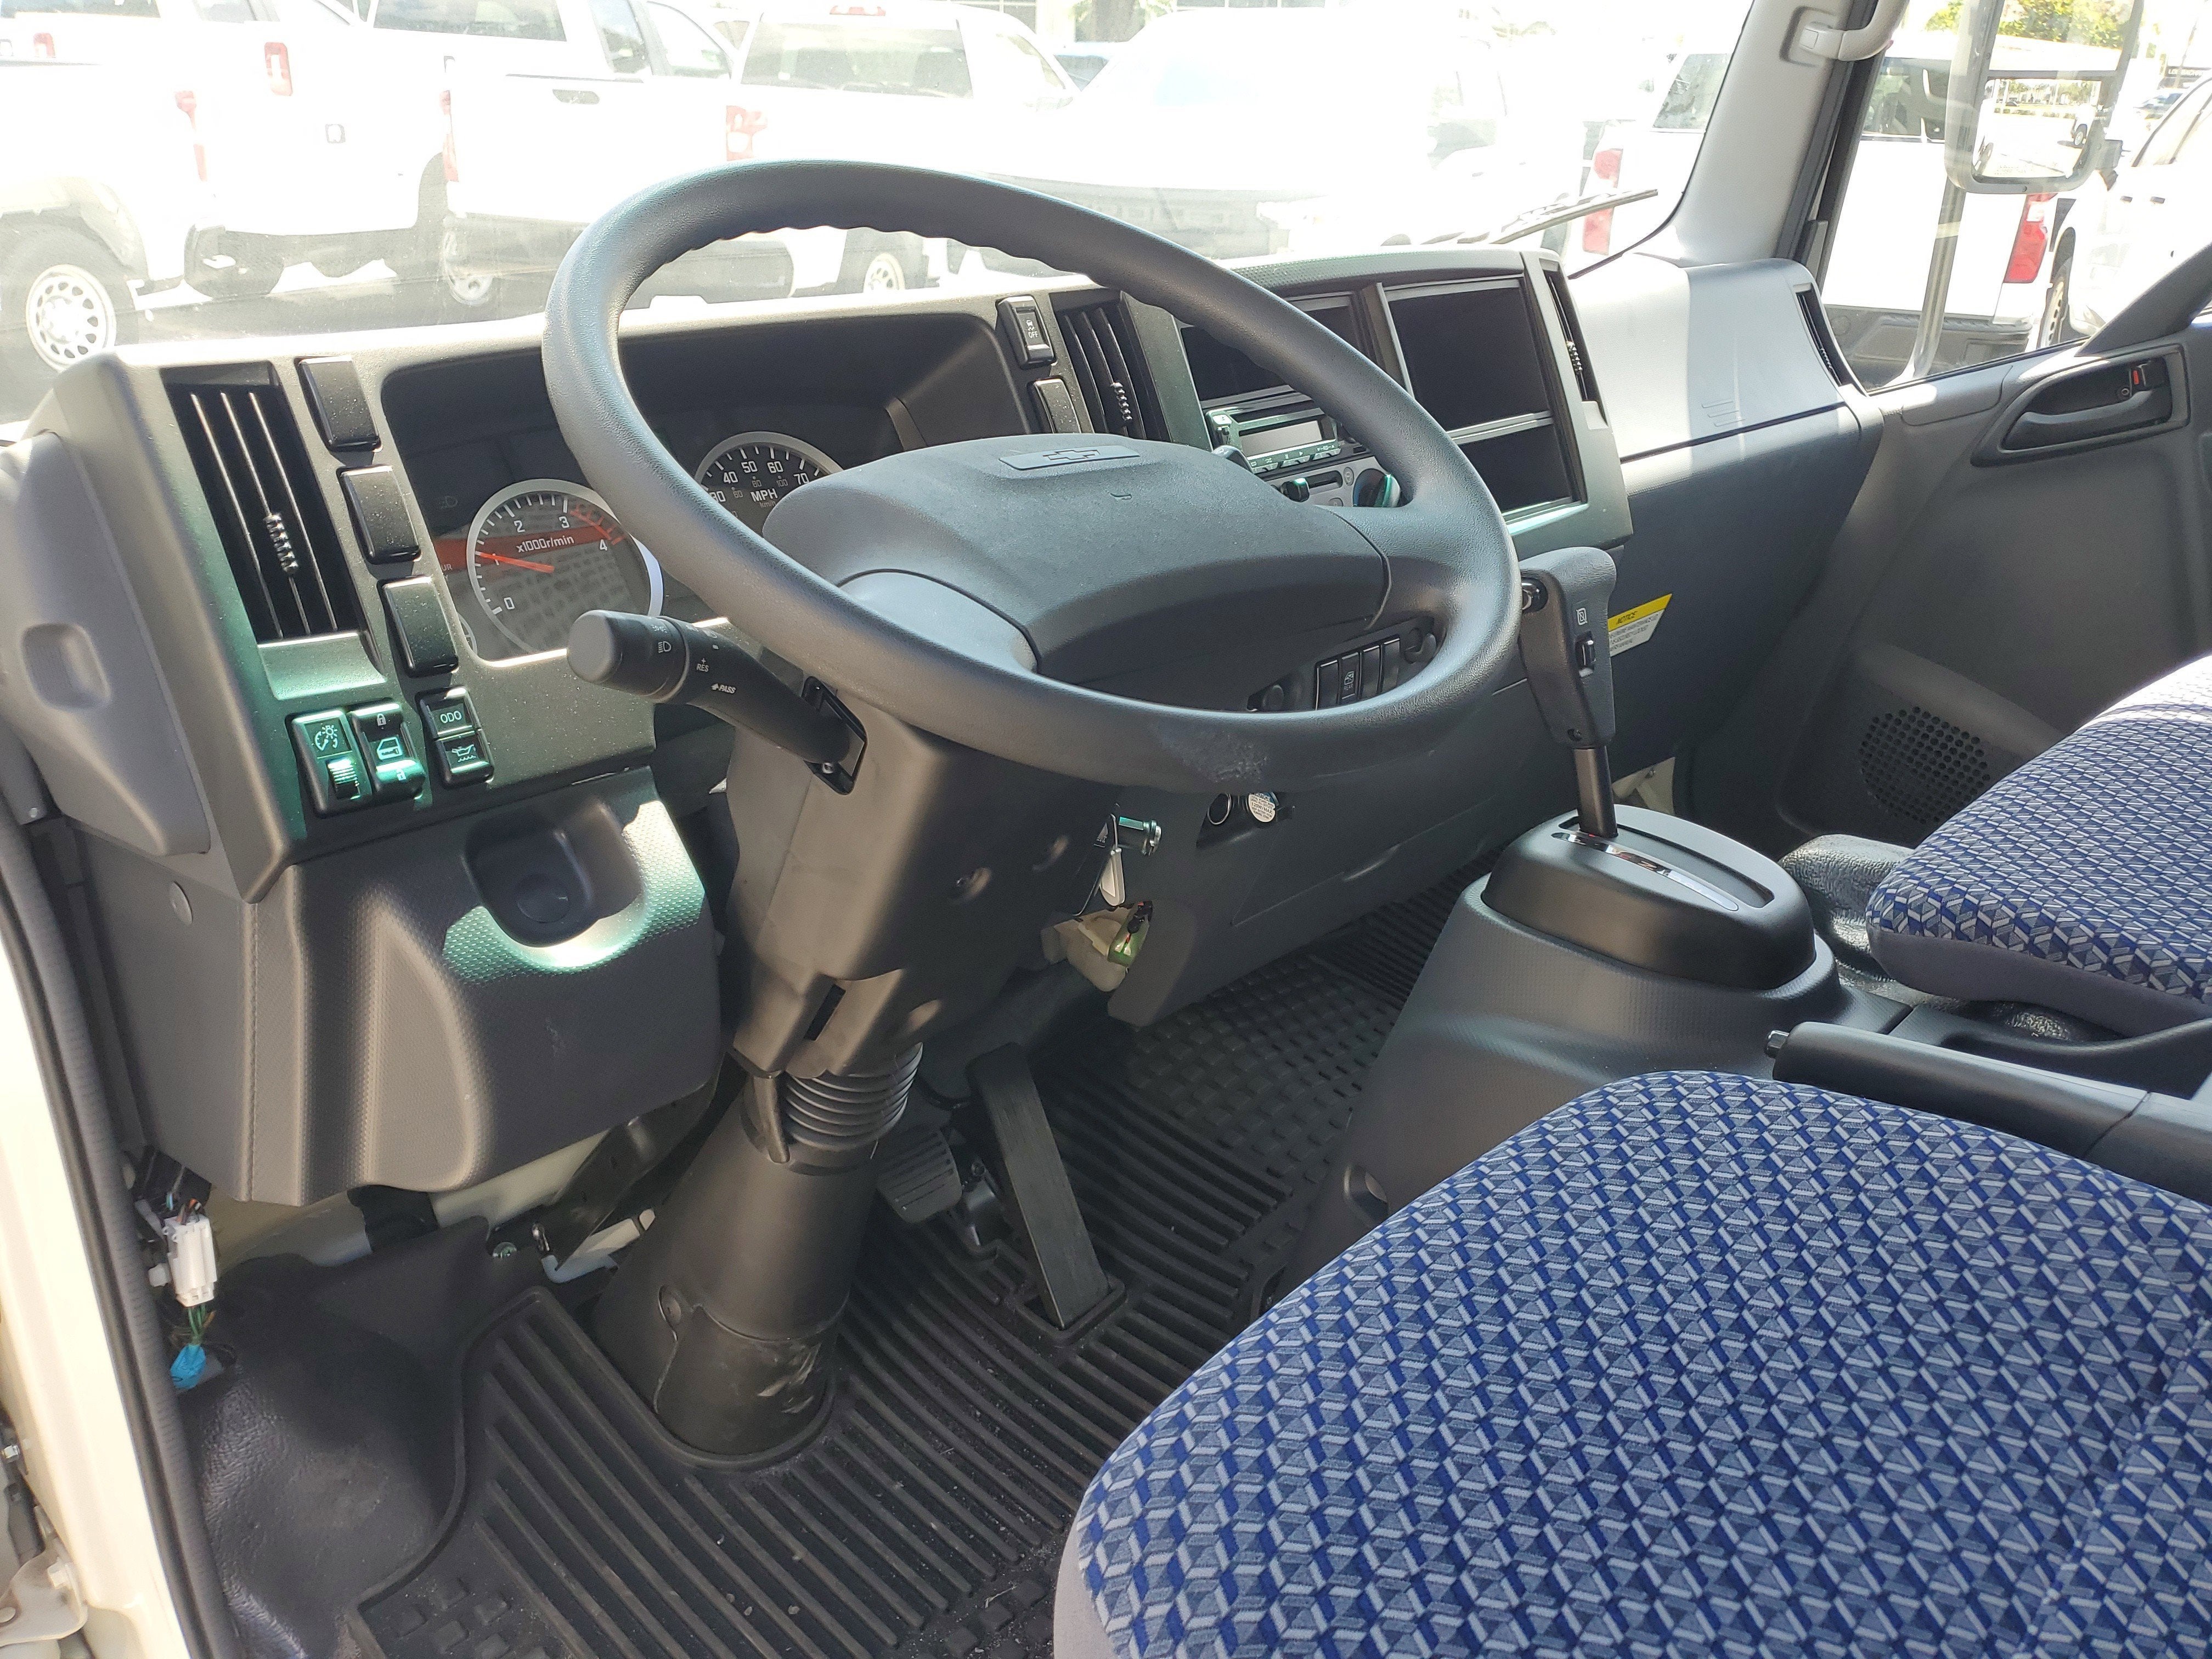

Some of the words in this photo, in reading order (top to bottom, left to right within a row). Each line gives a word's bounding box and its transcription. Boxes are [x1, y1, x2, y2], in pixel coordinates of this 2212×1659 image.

[741, 461, 758, 473] 50
[767, 461, 783, 473] 60
[723, 471, 738, 484] 40
[752, 479, 762, 488] 80
[776, 479, 788, 487] 100
[793, 472, 810, 485] 70
[733, 490, 743, 498] 60
[750, 488, 778, 502] MPH
[514, 520, 526, 533] 2
[558, 516, 570, 528] 3
[516, 535, 575, 553] x1000r/min
[599, 539, 608, 551] 4
[504, 596, 516, 610] 0
[696, 663, 709, 672] RES
[718, 684, 736, 694] PASS
[440, 710, 462, 724] ODO
